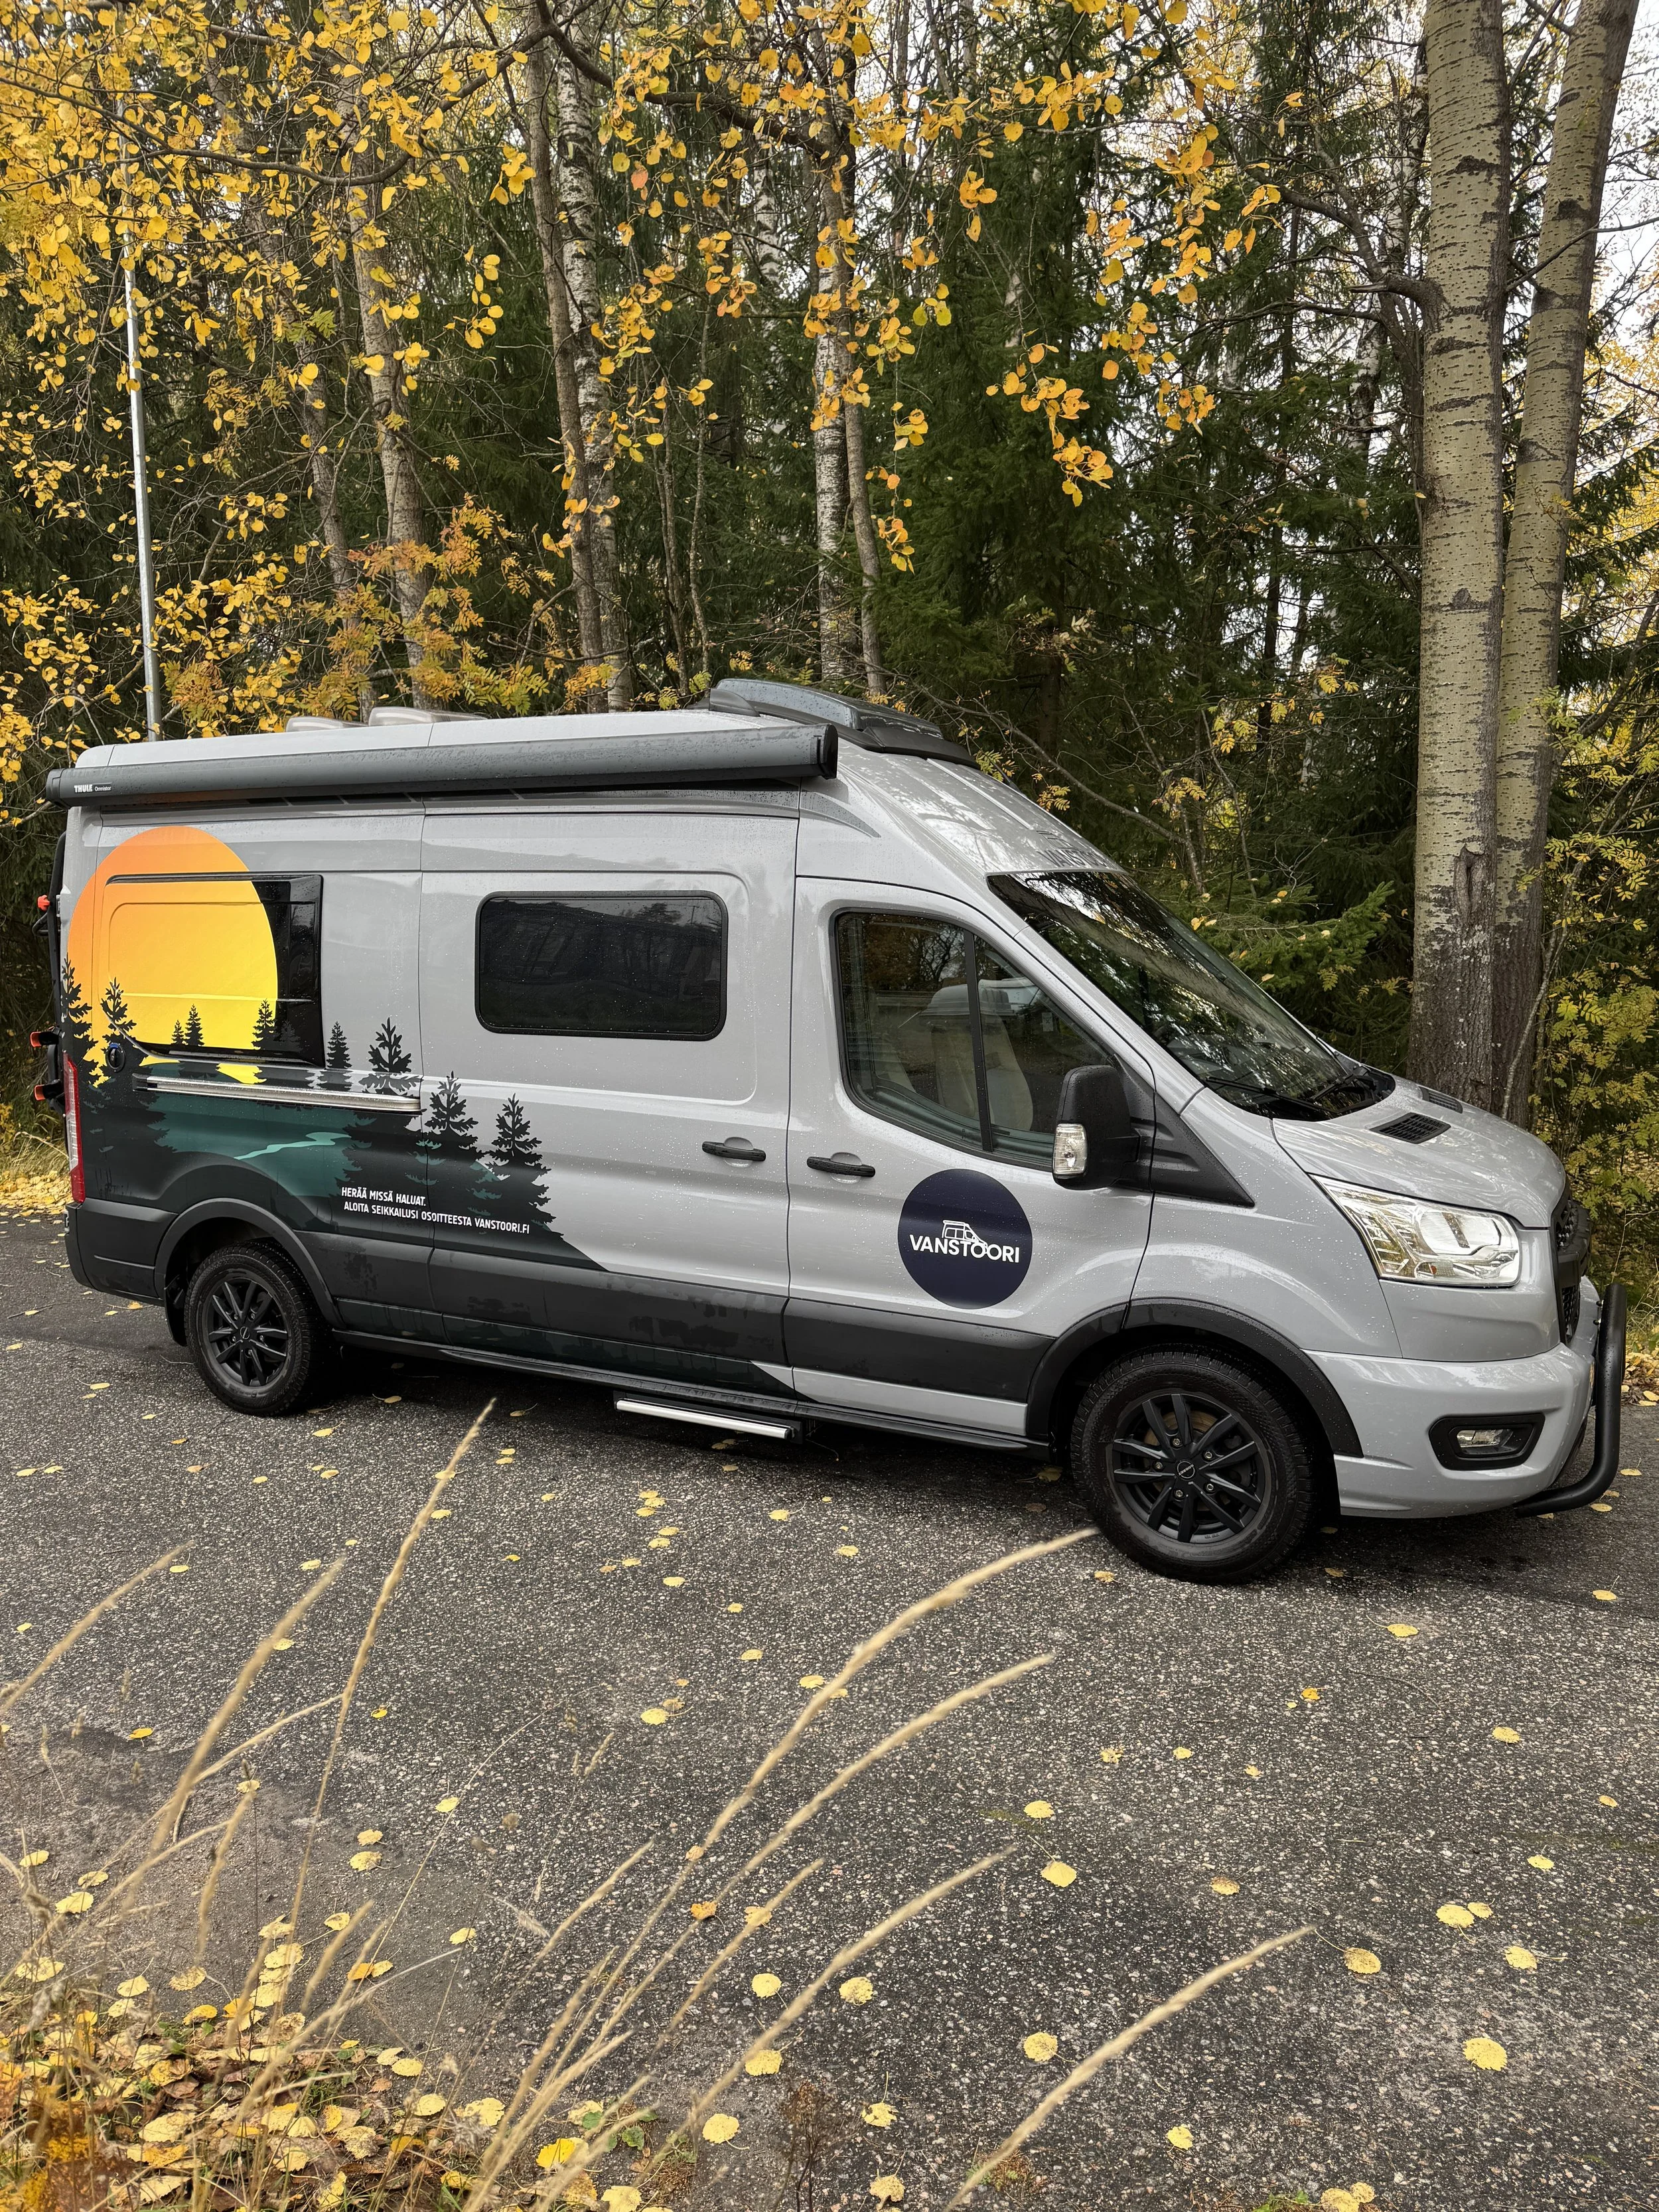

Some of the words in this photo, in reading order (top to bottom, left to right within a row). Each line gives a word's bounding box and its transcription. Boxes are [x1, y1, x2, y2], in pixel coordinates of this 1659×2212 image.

[74, 784, 93, 793] THULE
[341, 1187, 367, 1199] HERÄÄ
[369, 1190, 394, 1203] MISSÄ
[396, 1193, 426, 1207] HALUAT.
[344, 1201, 369, 1213] ALOITA
[372, 1205, 419, 1219] SEIKKAILUSI
[421, 1211, 472, 1226] OSOITTEESTA
[474, 1218, 530, 1234] VANSTOORI.FI
[909, 1234, 1020, 1263] VANSTOORI
